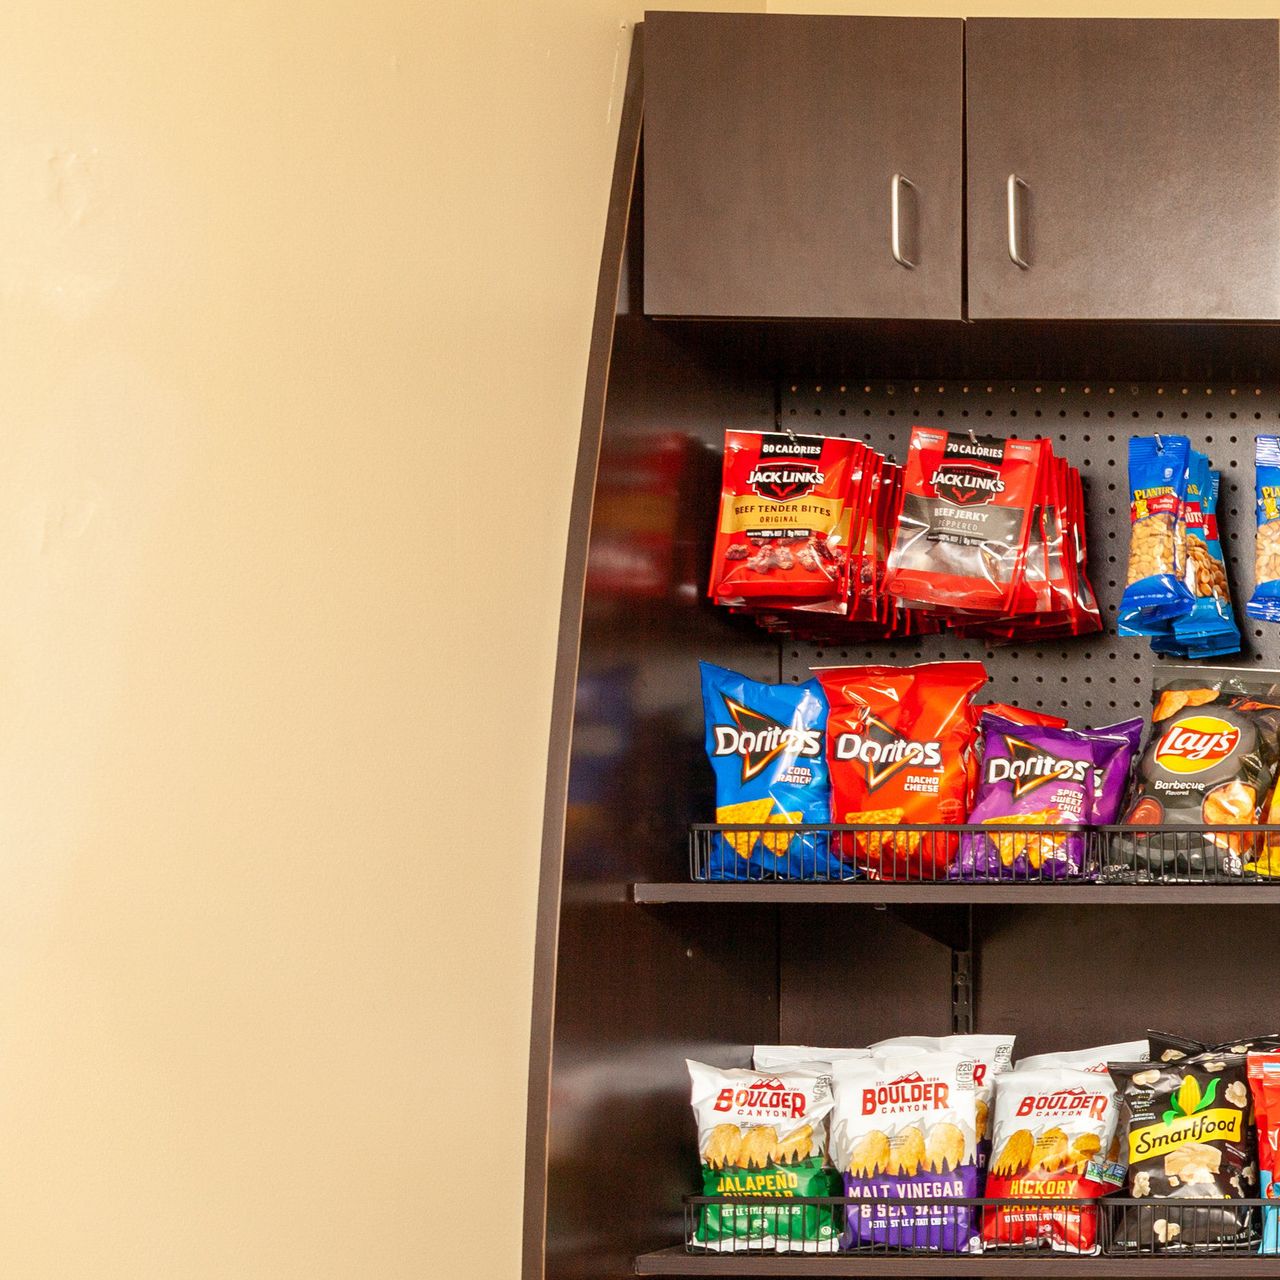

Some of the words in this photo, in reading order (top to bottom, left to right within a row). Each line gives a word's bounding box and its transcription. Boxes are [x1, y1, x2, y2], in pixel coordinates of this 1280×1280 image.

[763, 445, 770, 453] 80
[772, 445, 821, 455] CALORIES
[947, 443, 957, 453] 70
[958, 444, 1003, 458] CALORIES
[735, 506, 755, 515] BEEF
[757, 505, 798, 514] TENDER
[800, 505, 831, 517] BITES
[934, 508, 954, 518] BEEF
[954, 509, 988, 521] JERKY
[714, 726, 823, 757] Doritos
[836, 735, 941, 766] Doritos
[788, 766, 812, 776] COOL
[907, 776, 939, 785] NACHO
[1154, 780, 1205, 792] Barbecue
[904, 783, 939, 793] CHEESE
[1057, 788, 1083, 799] SPICY
[1050, 795, 1083, 806] SWEET
[713, 1088, 806, 1119] BOULDER
[881, 1104, 928, 1114] CANYON
[1016, 1095, 1107, 1122] BOULDER
[737, 1109, 788, 1118] CANYON
[1036, 1109, 1084, 1118] CANYON
[1135, 1115, 1236, 1155] Smartfood
[717, 1171, 798, 1191] JALAPEÑO
[1010, 1179, 1076, 1194] HICKORY
